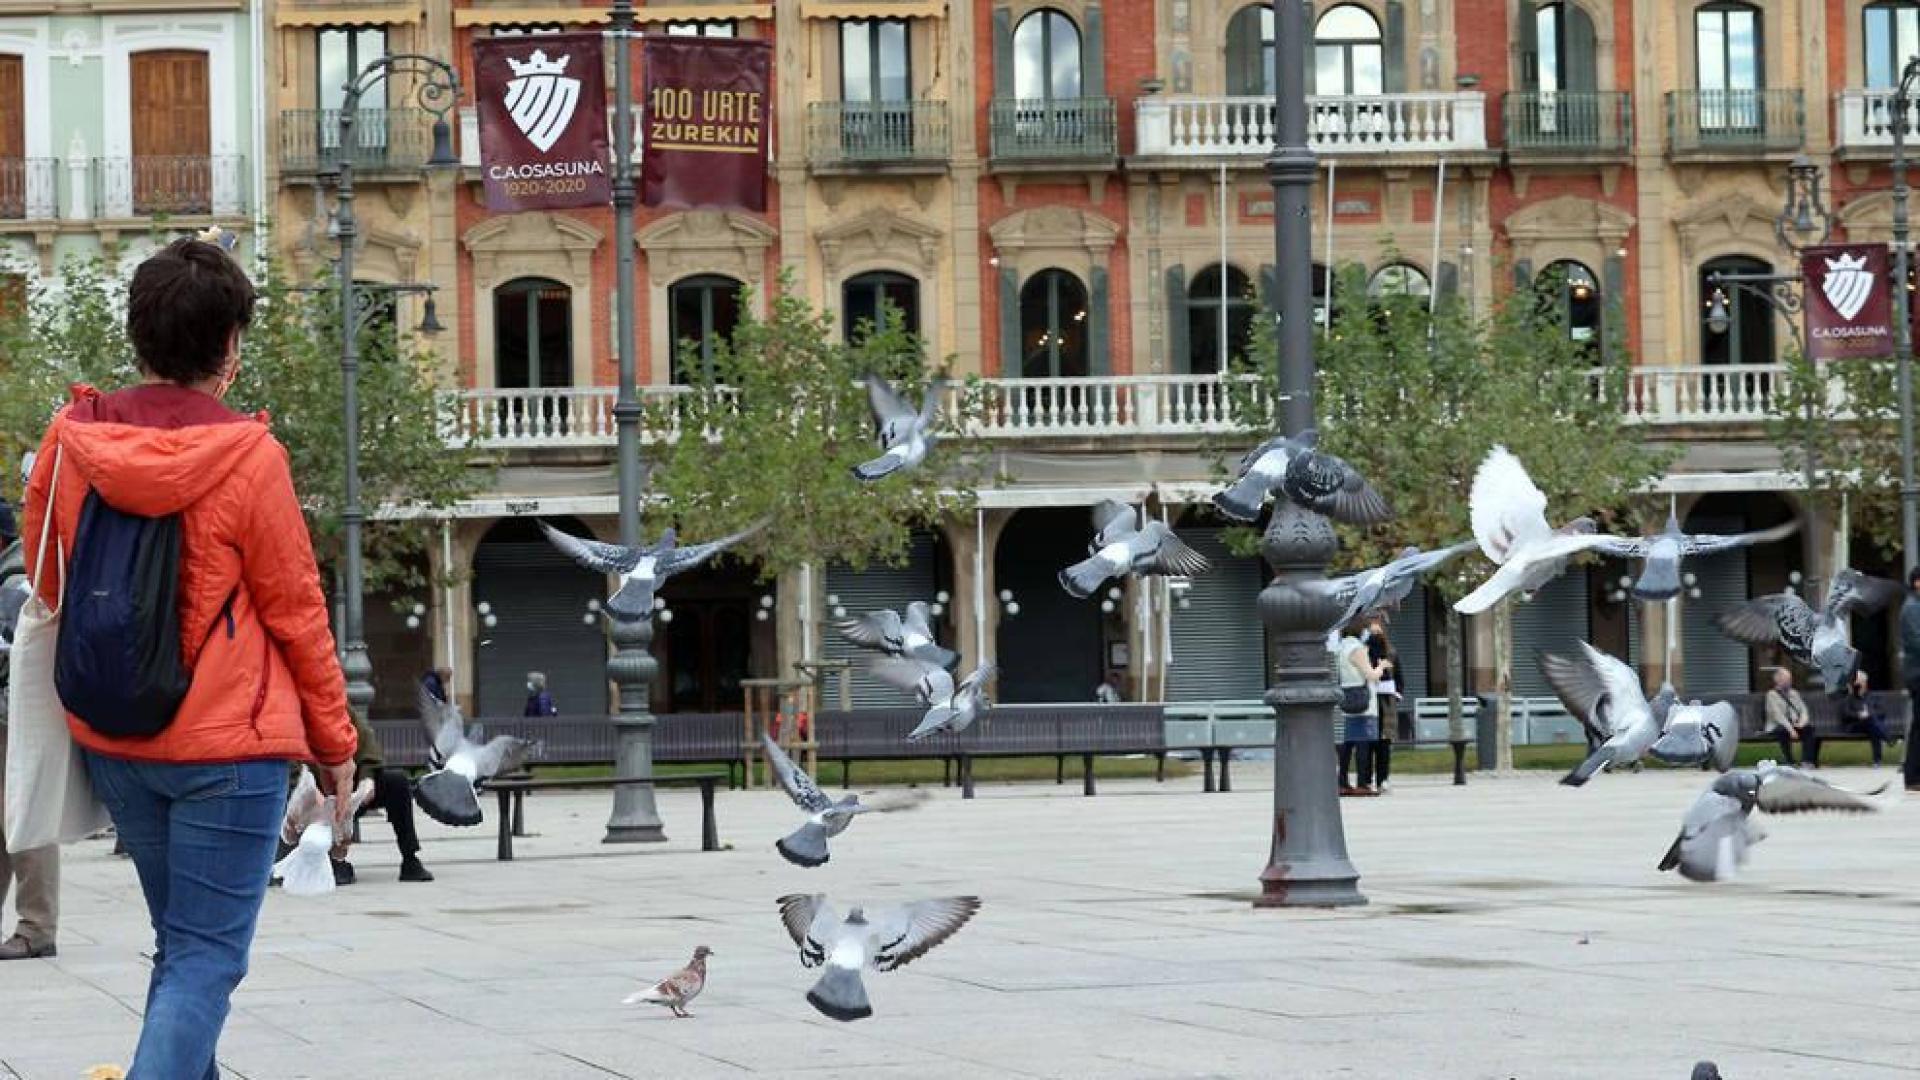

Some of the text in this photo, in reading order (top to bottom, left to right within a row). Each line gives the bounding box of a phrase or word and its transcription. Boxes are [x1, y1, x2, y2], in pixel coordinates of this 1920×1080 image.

[652, 87, 761, 123] 100 URTE
[651, 123, 760, 144] ZUREKIN
[503, 177, 587, 196] 1920-2020
